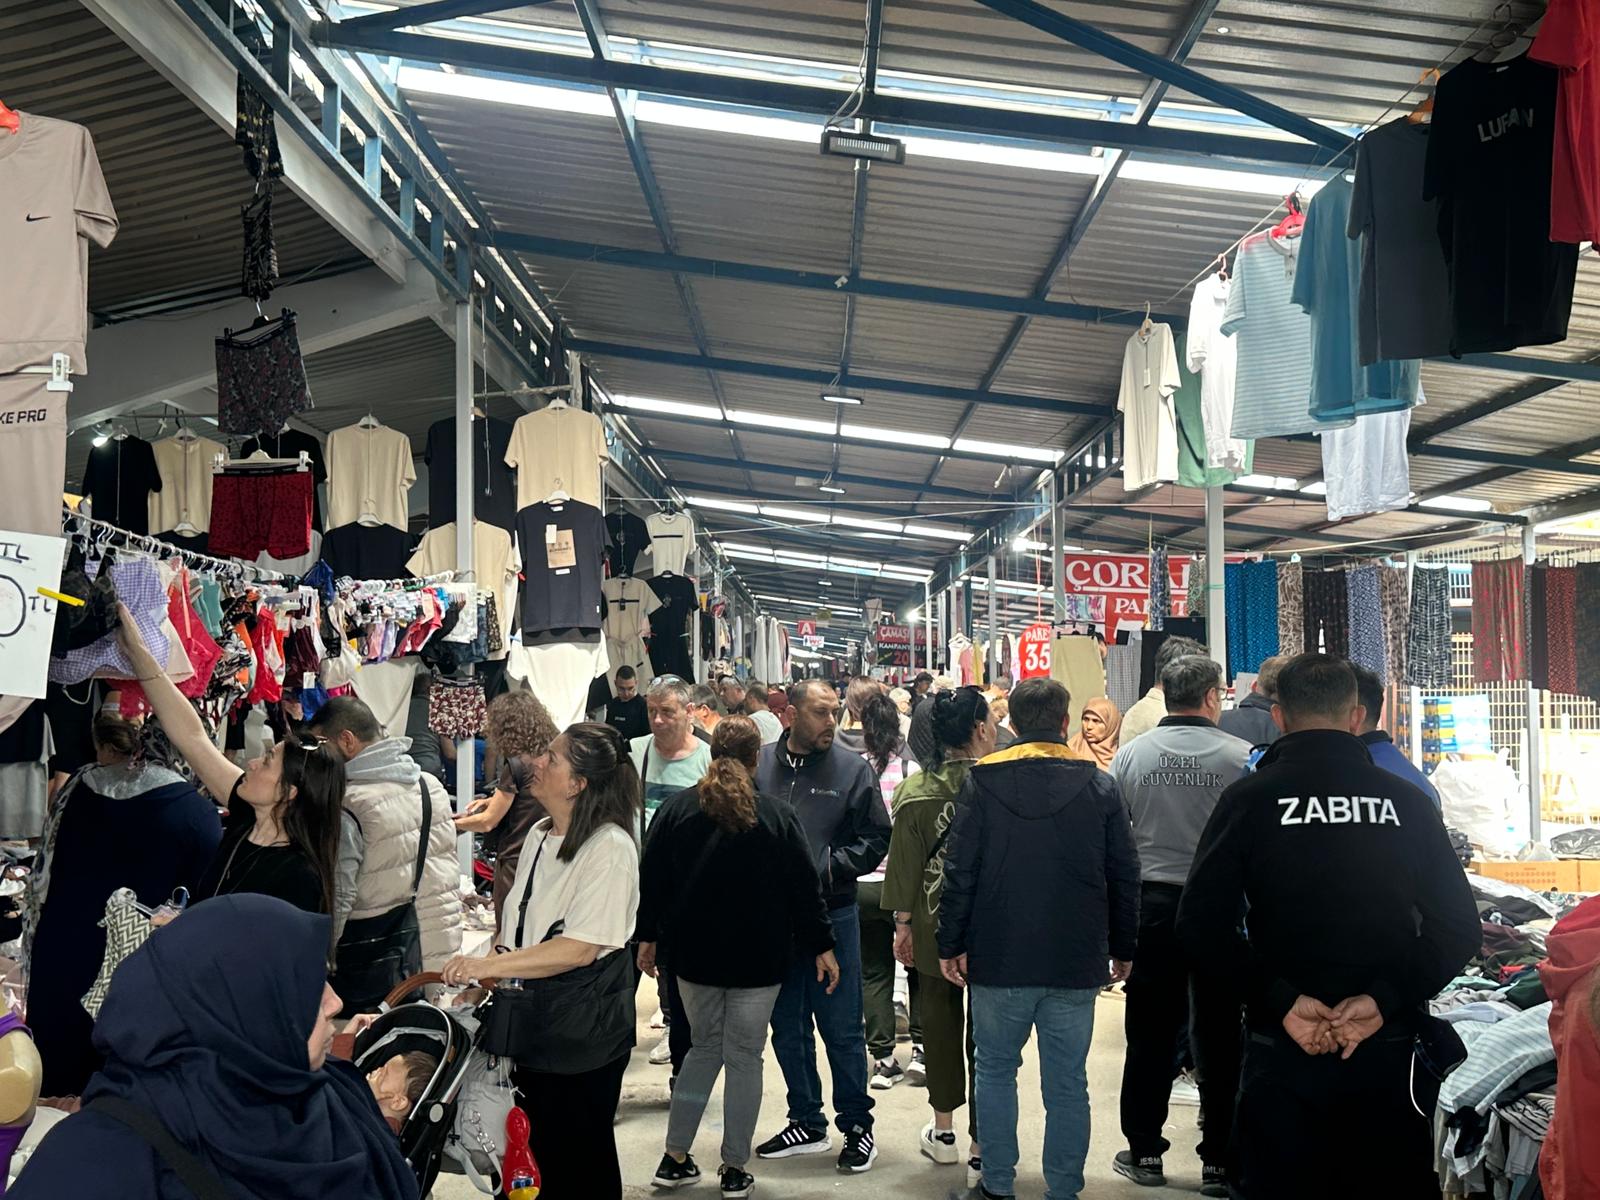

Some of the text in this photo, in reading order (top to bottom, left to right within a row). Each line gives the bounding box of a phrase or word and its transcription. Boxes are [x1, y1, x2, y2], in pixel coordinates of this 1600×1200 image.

[17, 408, 47, 423] PRO
[28, 596, 51, 612] TL
[801, 622, 813, 635] A
[1025, 643, 1050, 671] 35
[1159, 752, 1200, 769] ÖZEL
[1140, 769, 1223, 787] GÜVENLİK
[1278, 796, 1401, 826] ZABITA
